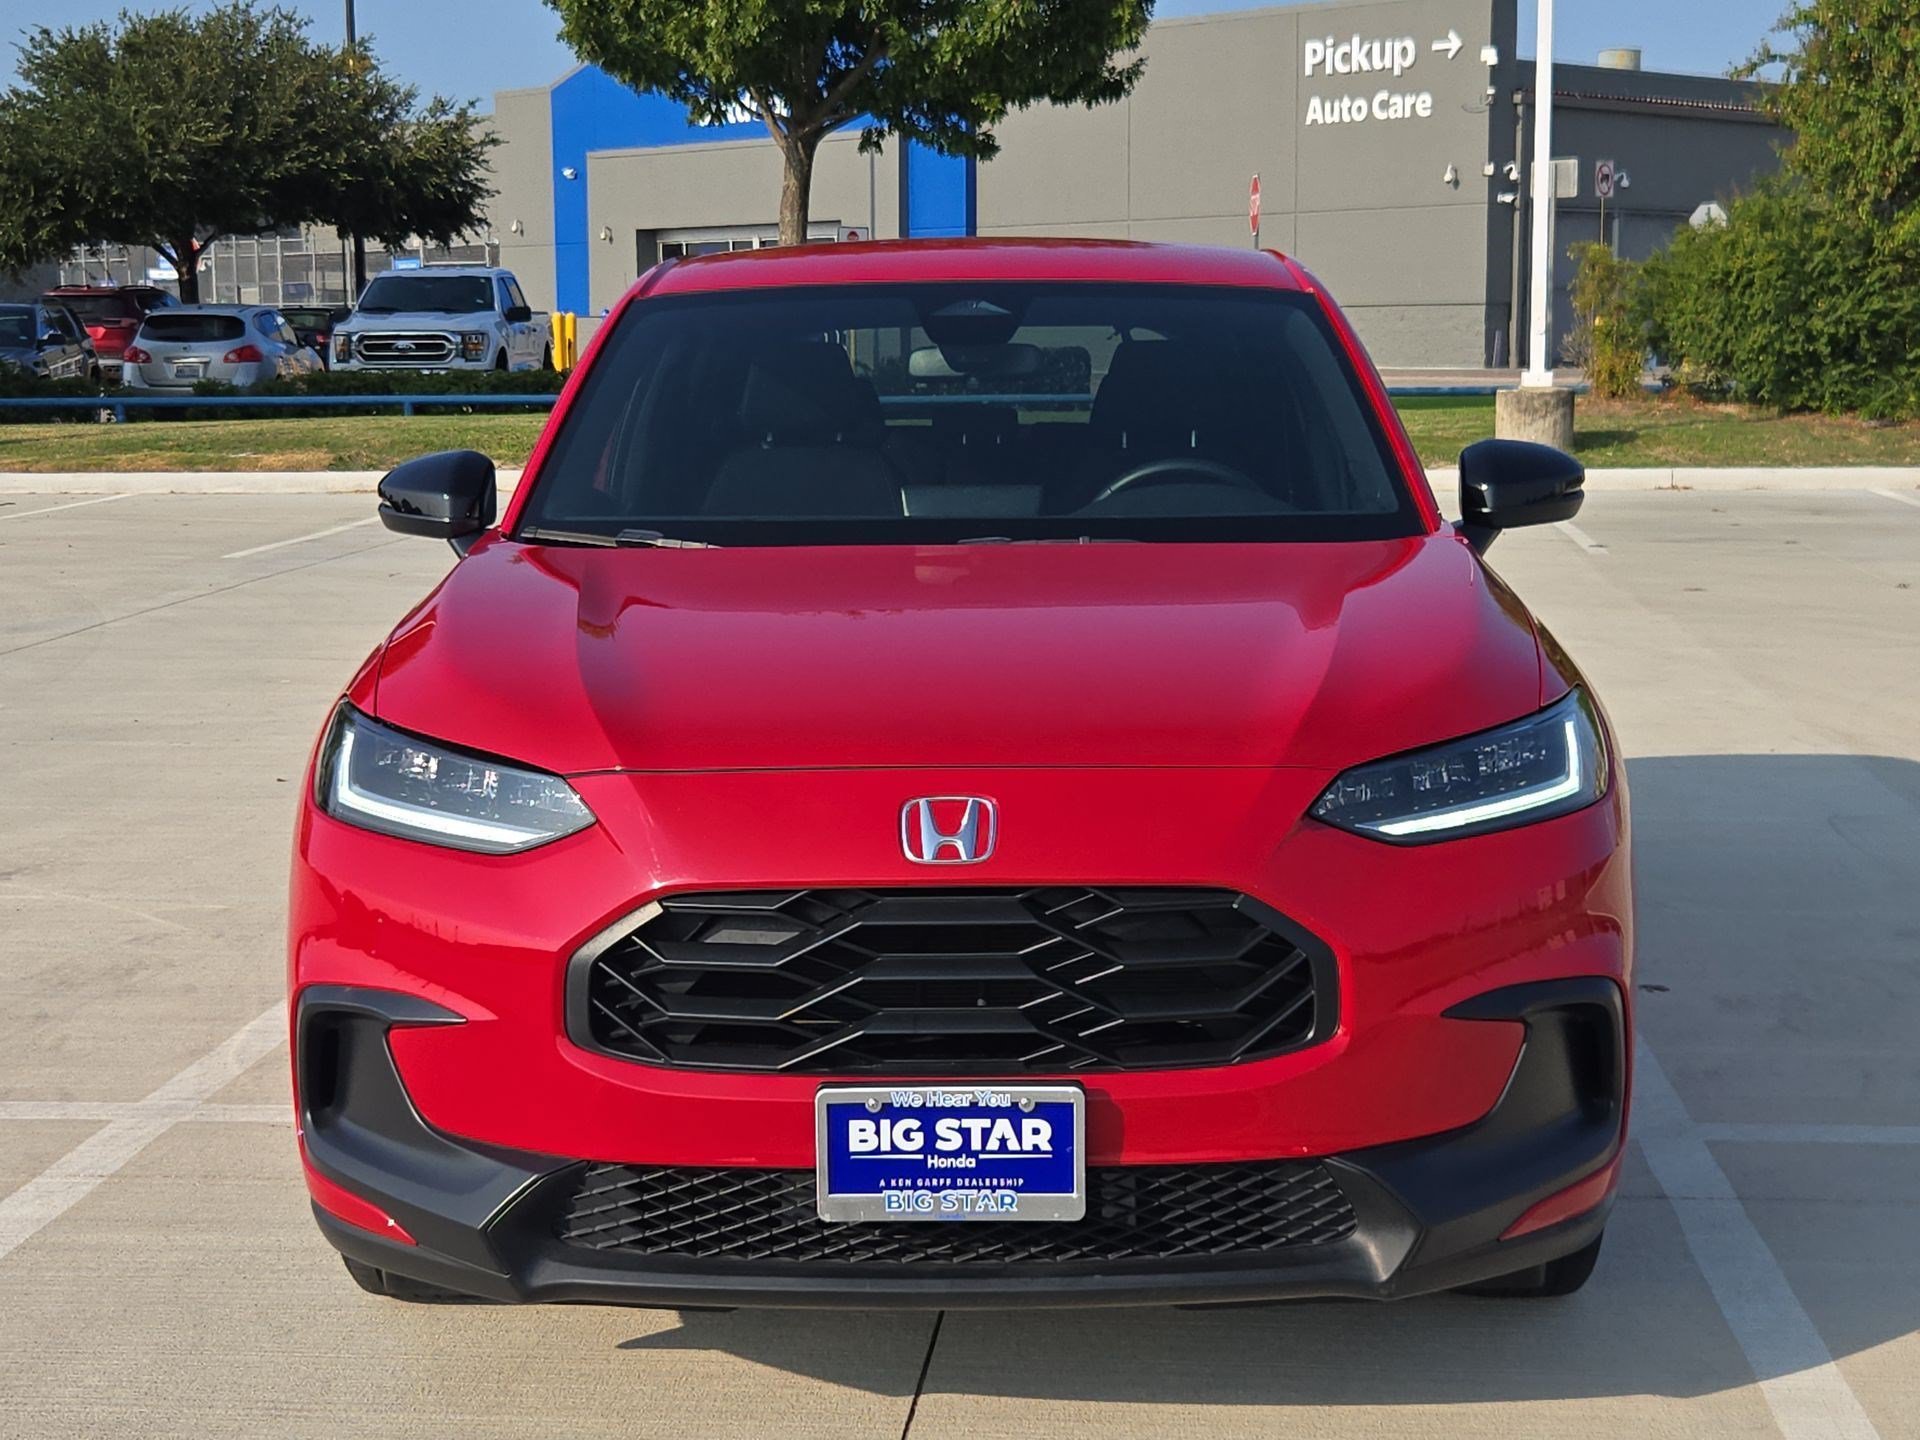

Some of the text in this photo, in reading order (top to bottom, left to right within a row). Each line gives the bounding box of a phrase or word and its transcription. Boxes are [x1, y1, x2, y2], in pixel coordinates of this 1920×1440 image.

[1304, 34, 1416, 77] Pickup
[1305, 90, 1432, 125] Auto Care
[890, 1090, 1011, 1108] We Hear You
[848, 1118, 1053, 1152] BIG STAR
[927, 1154, 976, 1169] Honda
[879, 1179, 886, 1188] A
[890, 1179, 912, 1188] KEN
[956, 1178, 1025, 1188] DEALERSHIP
[883, 1189, 1018, 1212] BIG STAR
